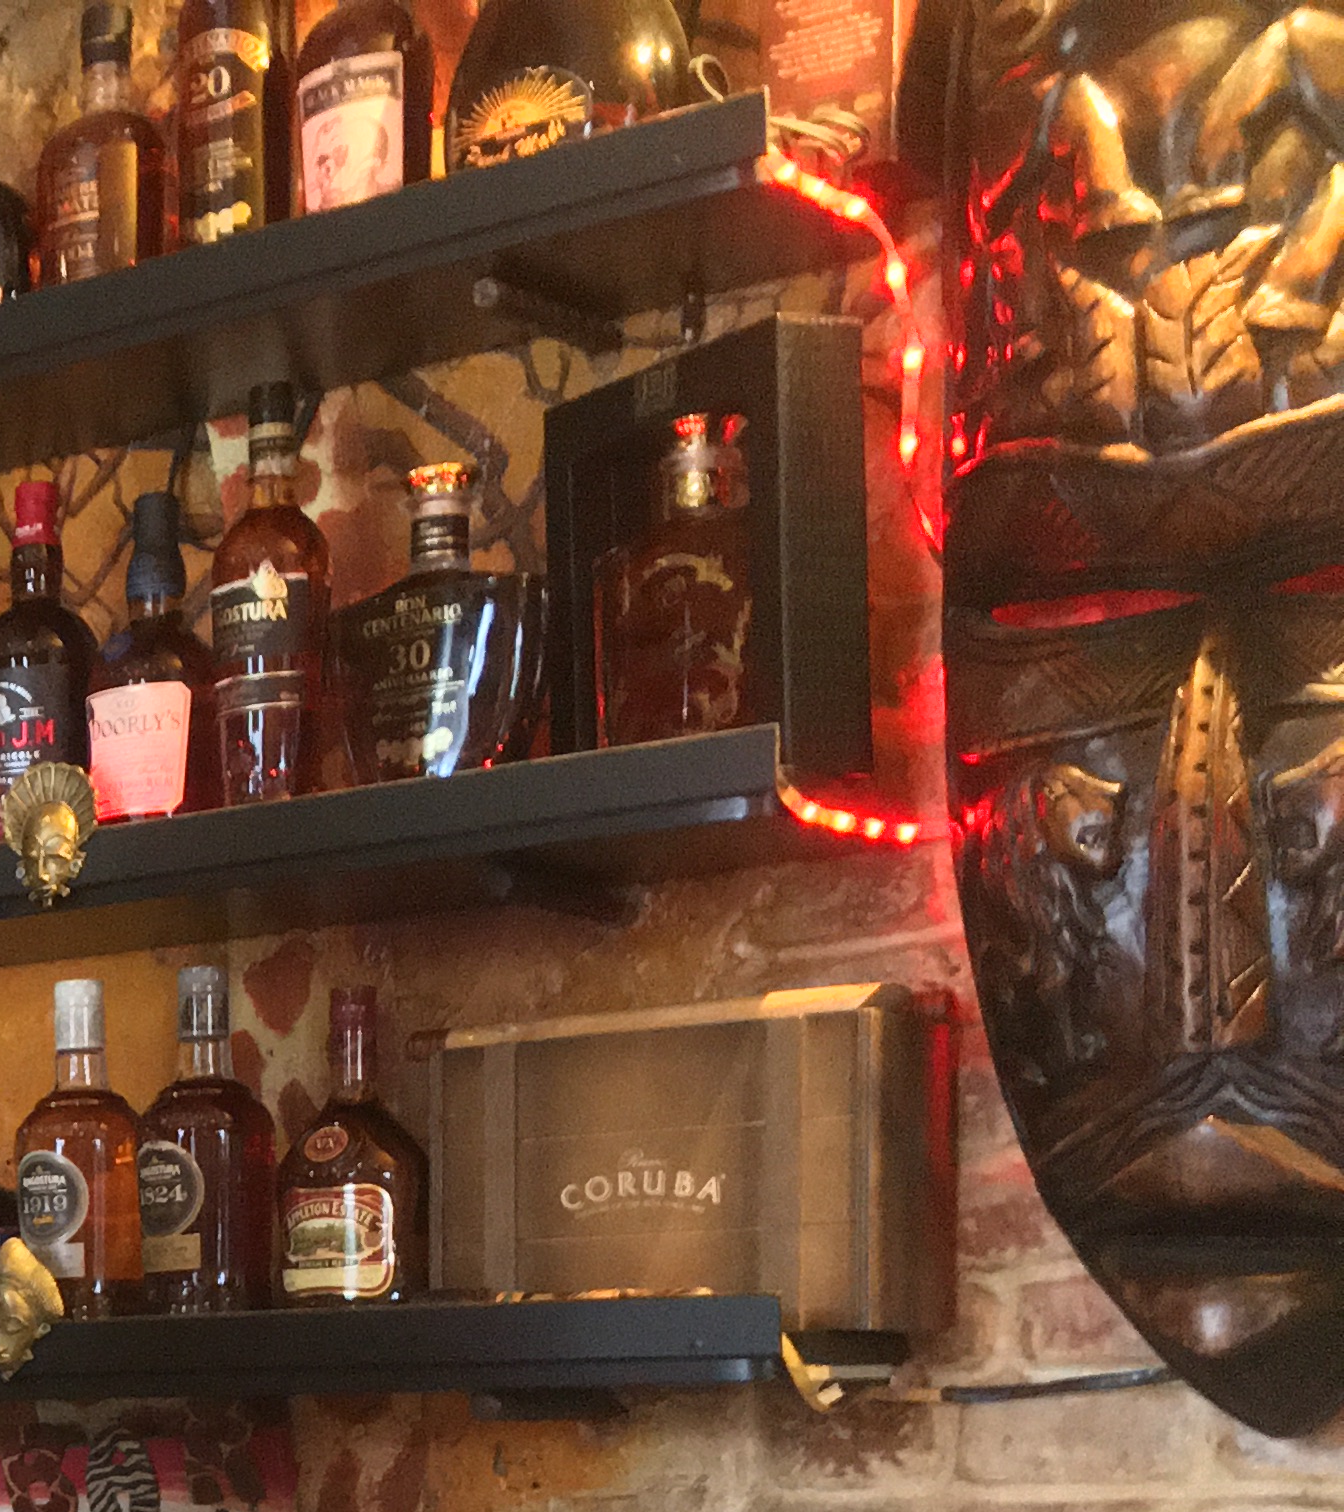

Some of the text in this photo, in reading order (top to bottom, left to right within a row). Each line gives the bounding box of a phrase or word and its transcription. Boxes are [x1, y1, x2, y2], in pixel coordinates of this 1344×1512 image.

[218, 599, 288, 627] OSTURA
[12, 718, 56, 749] J.M
[90, 710, 181, 742] DOORLY'S
[22, 1194, 68, 1215] 1919
[560, 1169, 724, 1211] CORUBA
